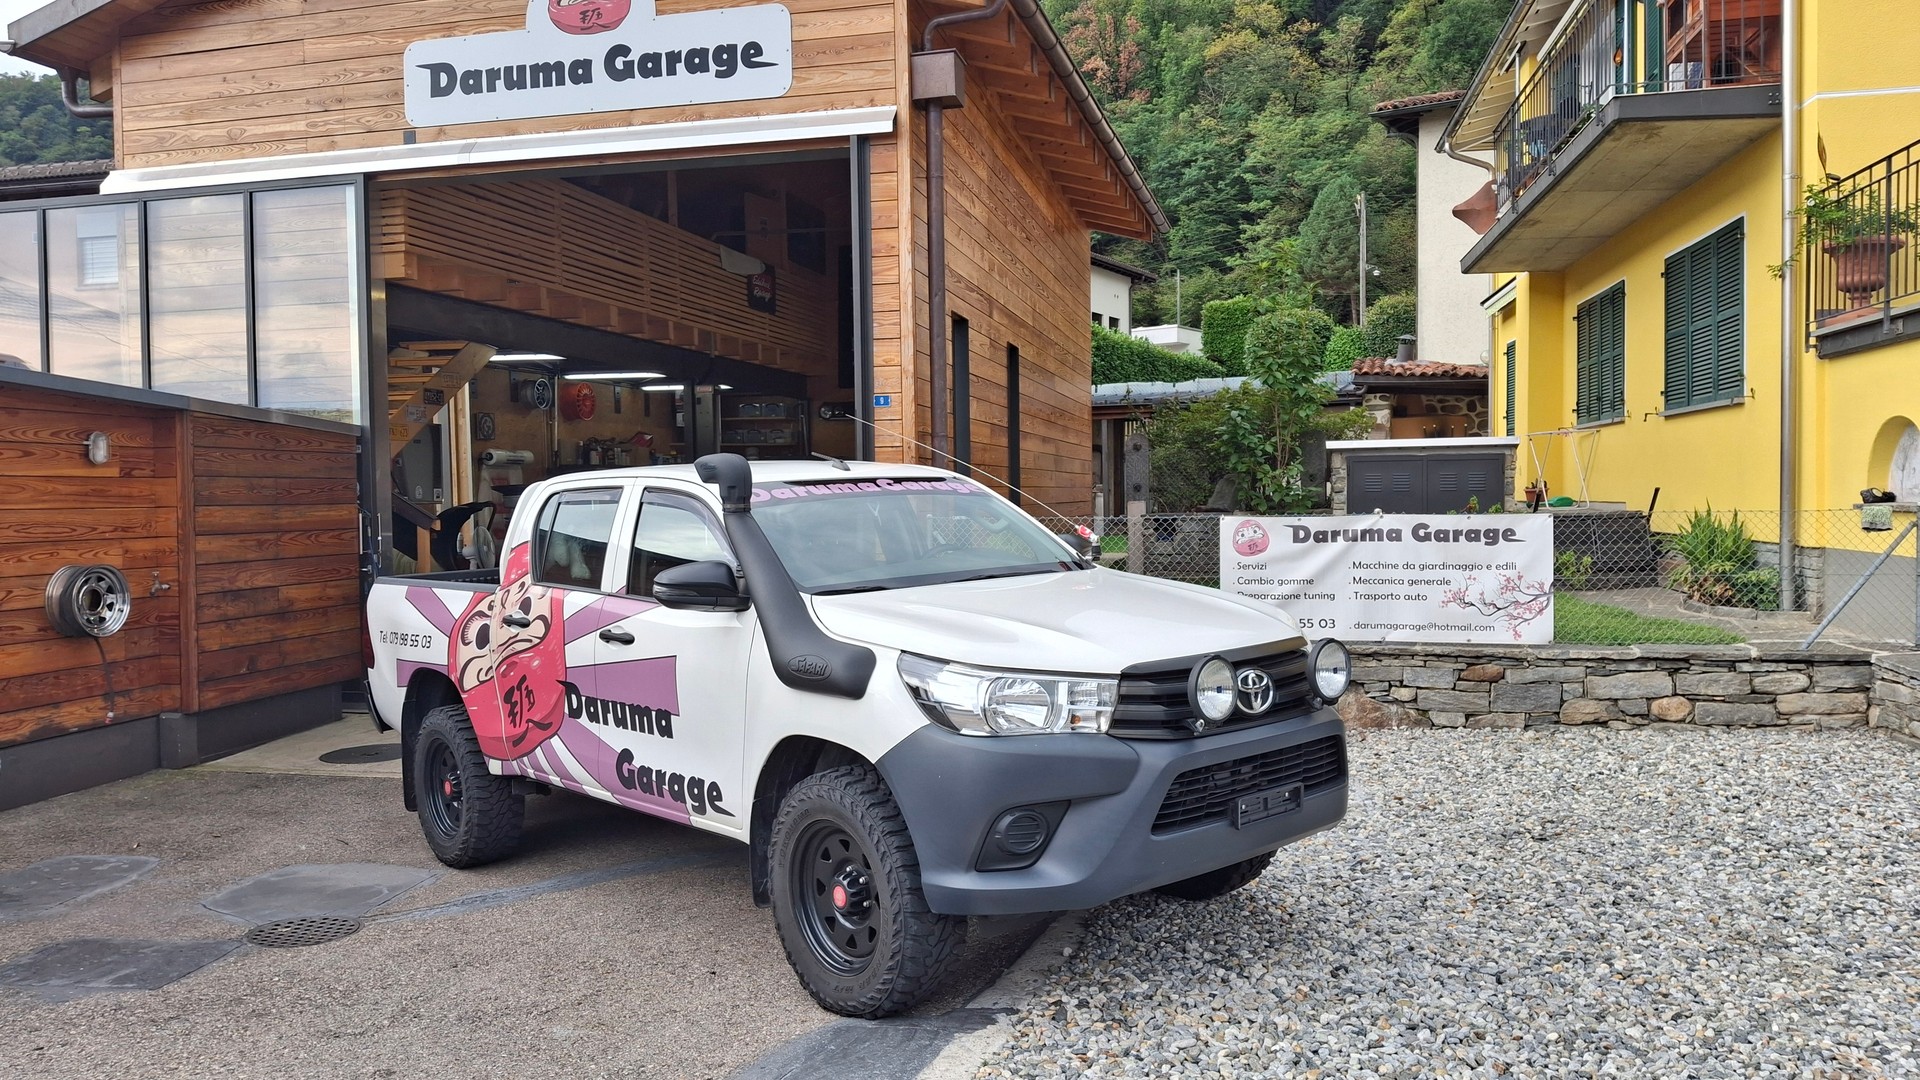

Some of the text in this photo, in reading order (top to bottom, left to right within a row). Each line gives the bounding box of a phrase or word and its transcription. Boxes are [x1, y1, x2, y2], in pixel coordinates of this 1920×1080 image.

[415, 41, 779, 98] Daruma Garage
[1283, 523, 1526, 546] Daruma Garage
[1237, 561, 1267, 570] Servizi
[1352, 561, 1517, 571] Macchine da giardinaggio e edili
[1237, 576, 1315, 586] Cambio gomme
[1352, 576, 1452, 587] Meccanica generale
[1303, 591, 1336, 602] tuning
[1353, 592, 1428, 602] Trasporto auto
[1299, 618, 1314, 629] 55
[1353, 621, 1495, 633] darumagarage@hotmail.com
[389, 631, 398, 645] 079
[409, 633, 420, 648] 55
[421, 634, 432, 649] 03
[556, 679, 674, 738] Daruma
[616, 747, 736, 817] Garage
